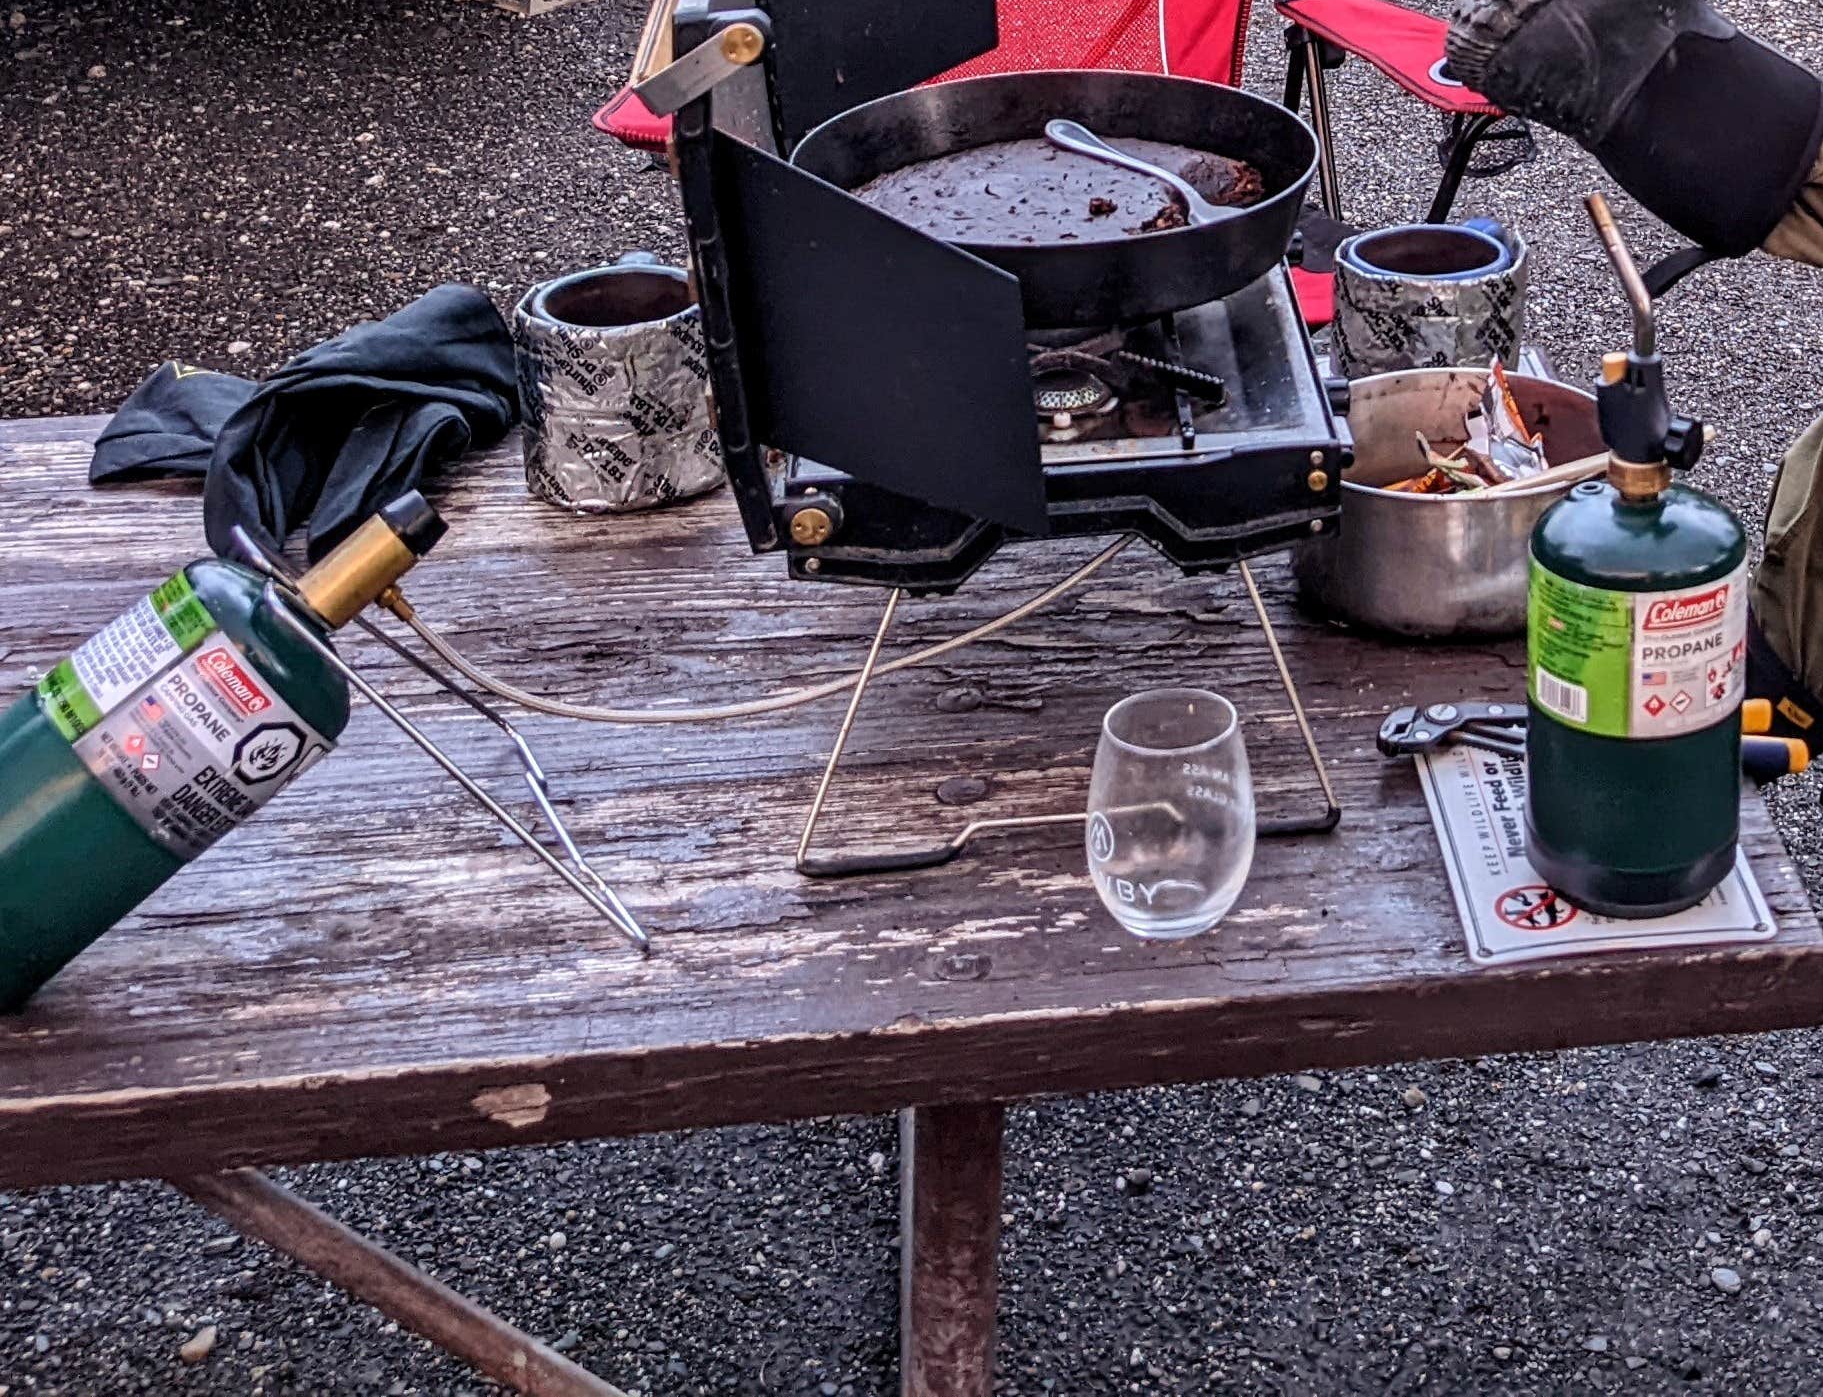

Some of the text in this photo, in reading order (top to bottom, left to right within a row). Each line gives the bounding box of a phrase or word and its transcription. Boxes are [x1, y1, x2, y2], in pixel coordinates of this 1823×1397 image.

[1649, 597, 1715, 625] Coleman
[1641, 633, 1724, 662] PROPANE
[206, 650, 252, 705] Coleman
[168, 673, 232, 744] PROPANE
[193, 765, 248, 812] EXTREME
[1501, 753, 1526, 801] Wildli
[171, 783, 222, 826] DANGER
[1462, 783, 1491, 840] WILDLIFE
[1483, 761, 1527, 858] Never Feed or
[1482, 845, 1501, 877] KEEP
